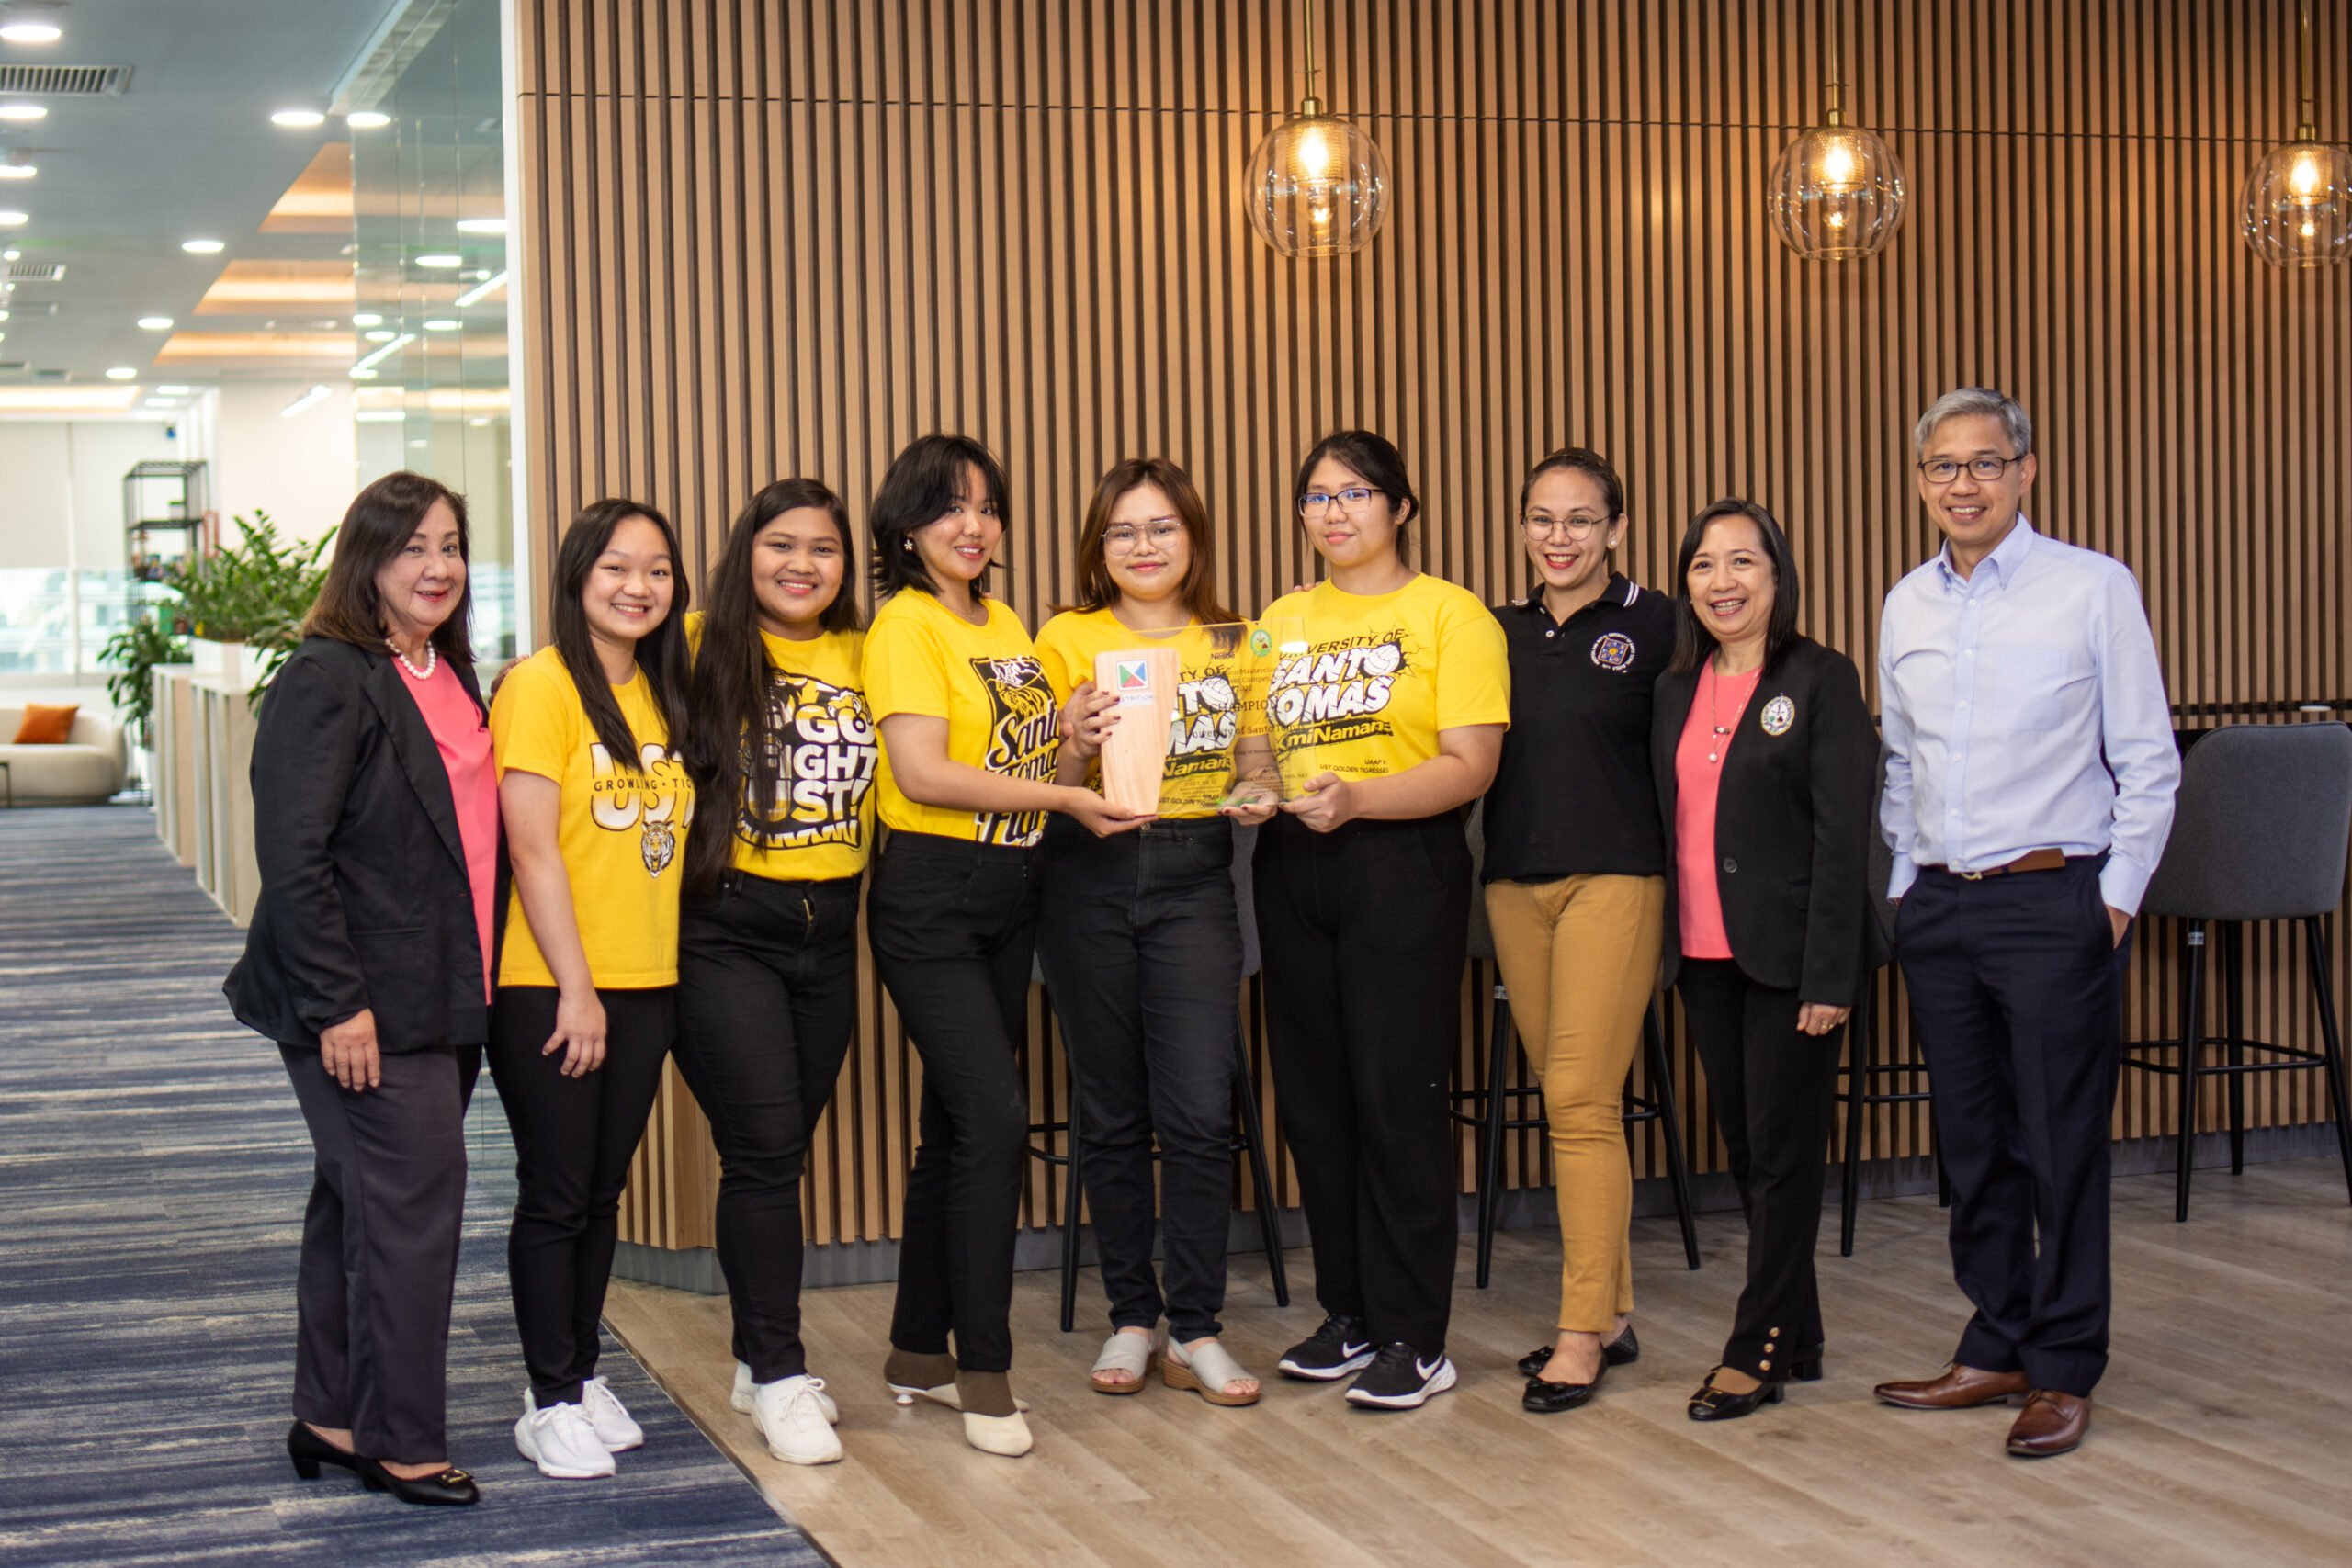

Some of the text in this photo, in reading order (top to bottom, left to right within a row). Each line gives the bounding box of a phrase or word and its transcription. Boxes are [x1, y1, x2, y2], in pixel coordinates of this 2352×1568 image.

[1279, 637, 1377, 660] VERSITY
[1383, 628, 1405, 644] OF
[795, 705, 876, 745] GO
[985, 700, 1059, 769] Sant
[594, 778, 658, 792] GROWLING
